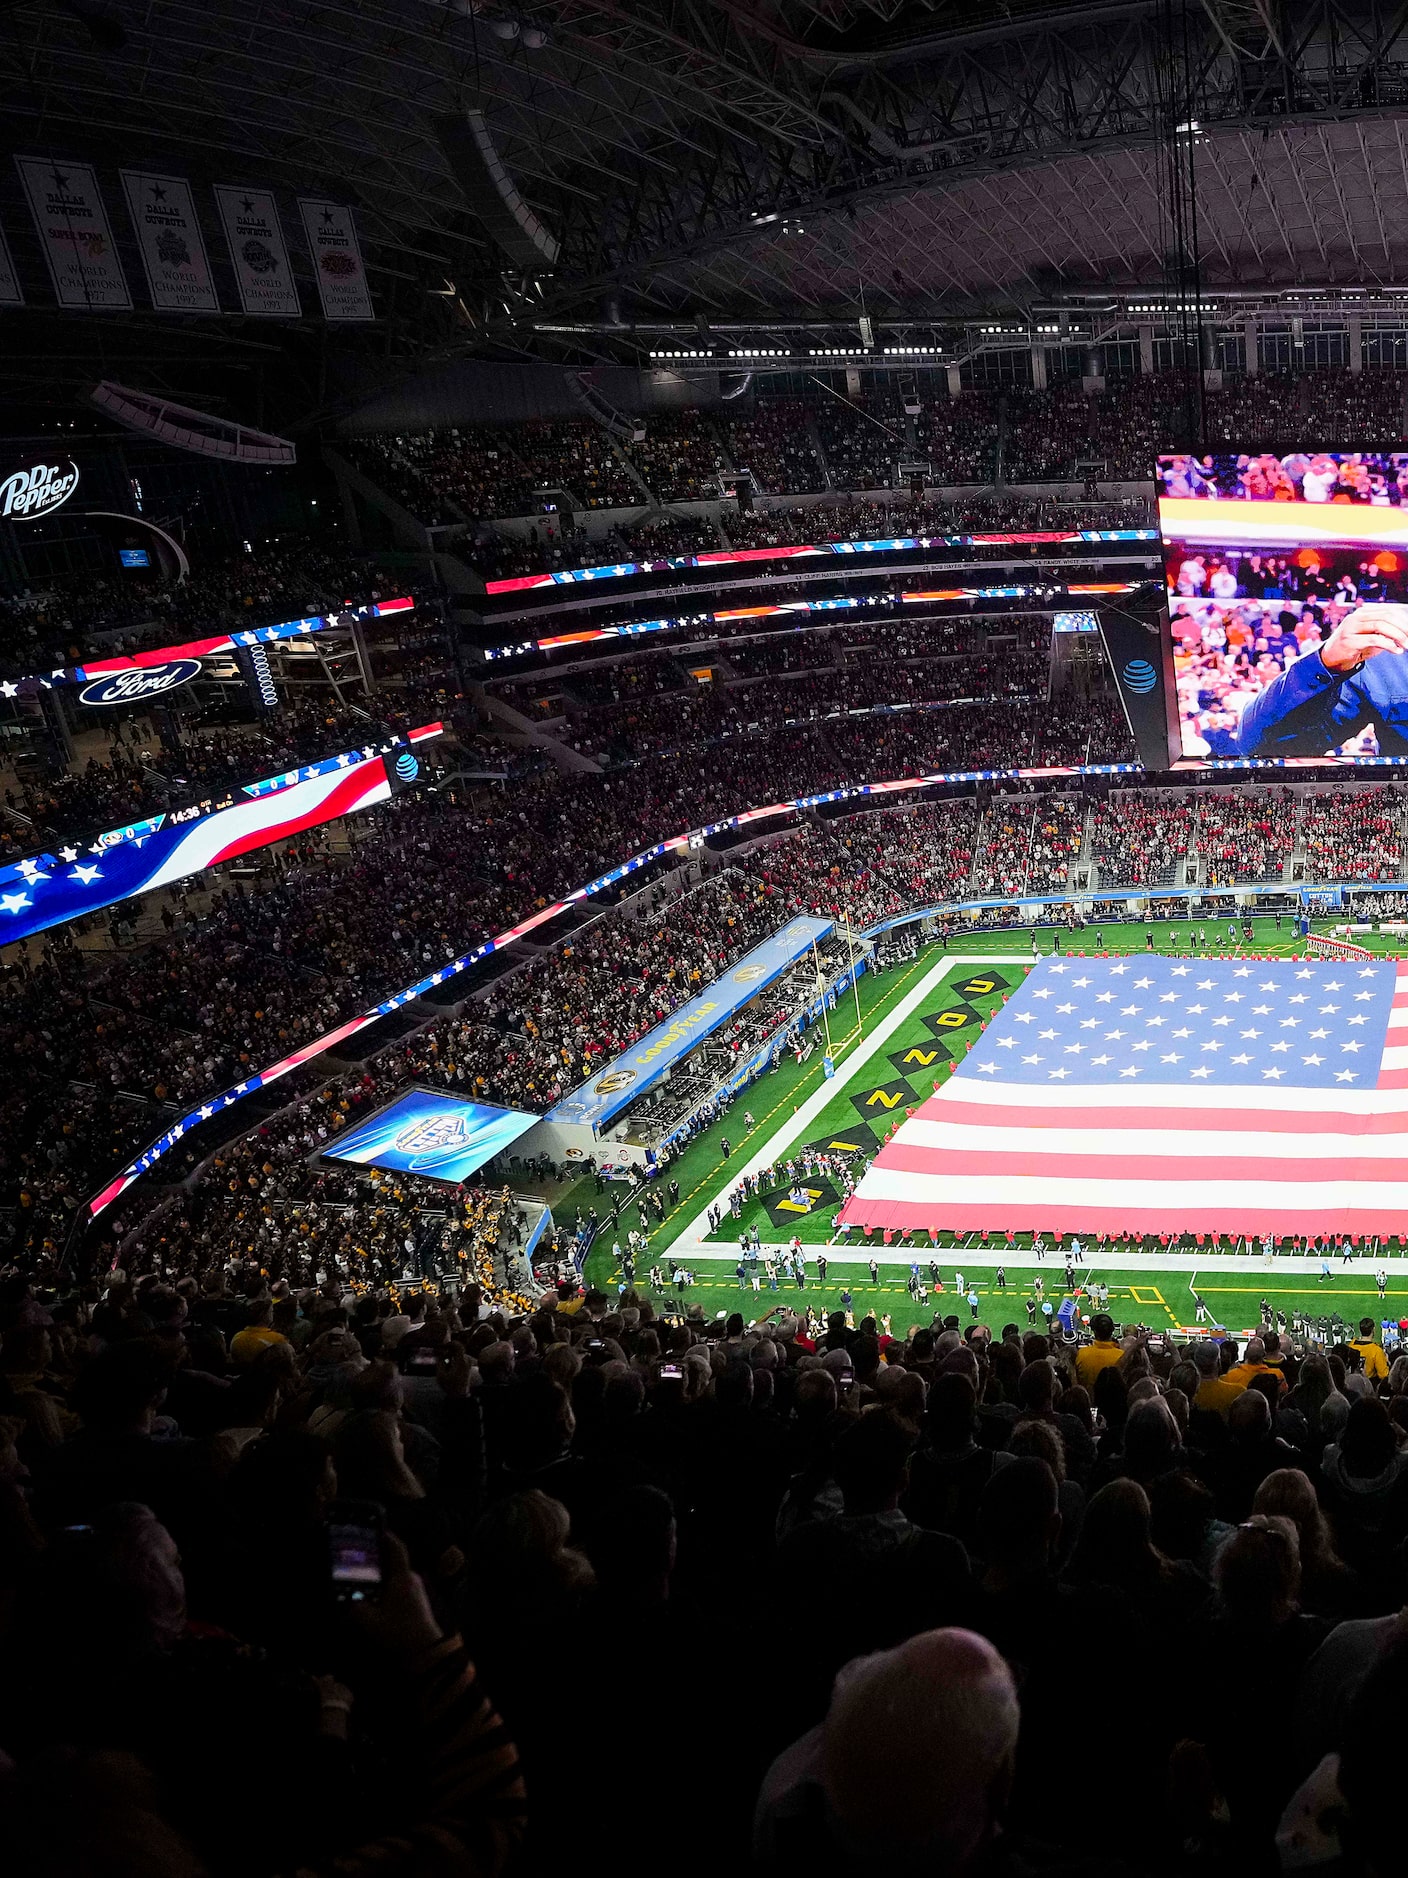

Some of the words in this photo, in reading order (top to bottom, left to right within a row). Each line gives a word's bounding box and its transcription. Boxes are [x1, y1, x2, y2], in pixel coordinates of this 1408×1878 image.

[47, 193, 85, 205] DALLAS
[146, 205, 180, 216] DALLAS
[237, 216, 266, 227] DALLAS
[162, 271, 197, 281] WORLD
[60, 277, 122, 290] CHAMPIONS
[155, 282, 211, 295] CHAMPIONS
[29, 464, 60, 490] Dr
[0, 471, 75, 517] Pepper
[101, 665, 184, 701] Ford
[169, 806, 200, 825] 14:36
[636, 1002, 720, 1064] GOODYEAR
